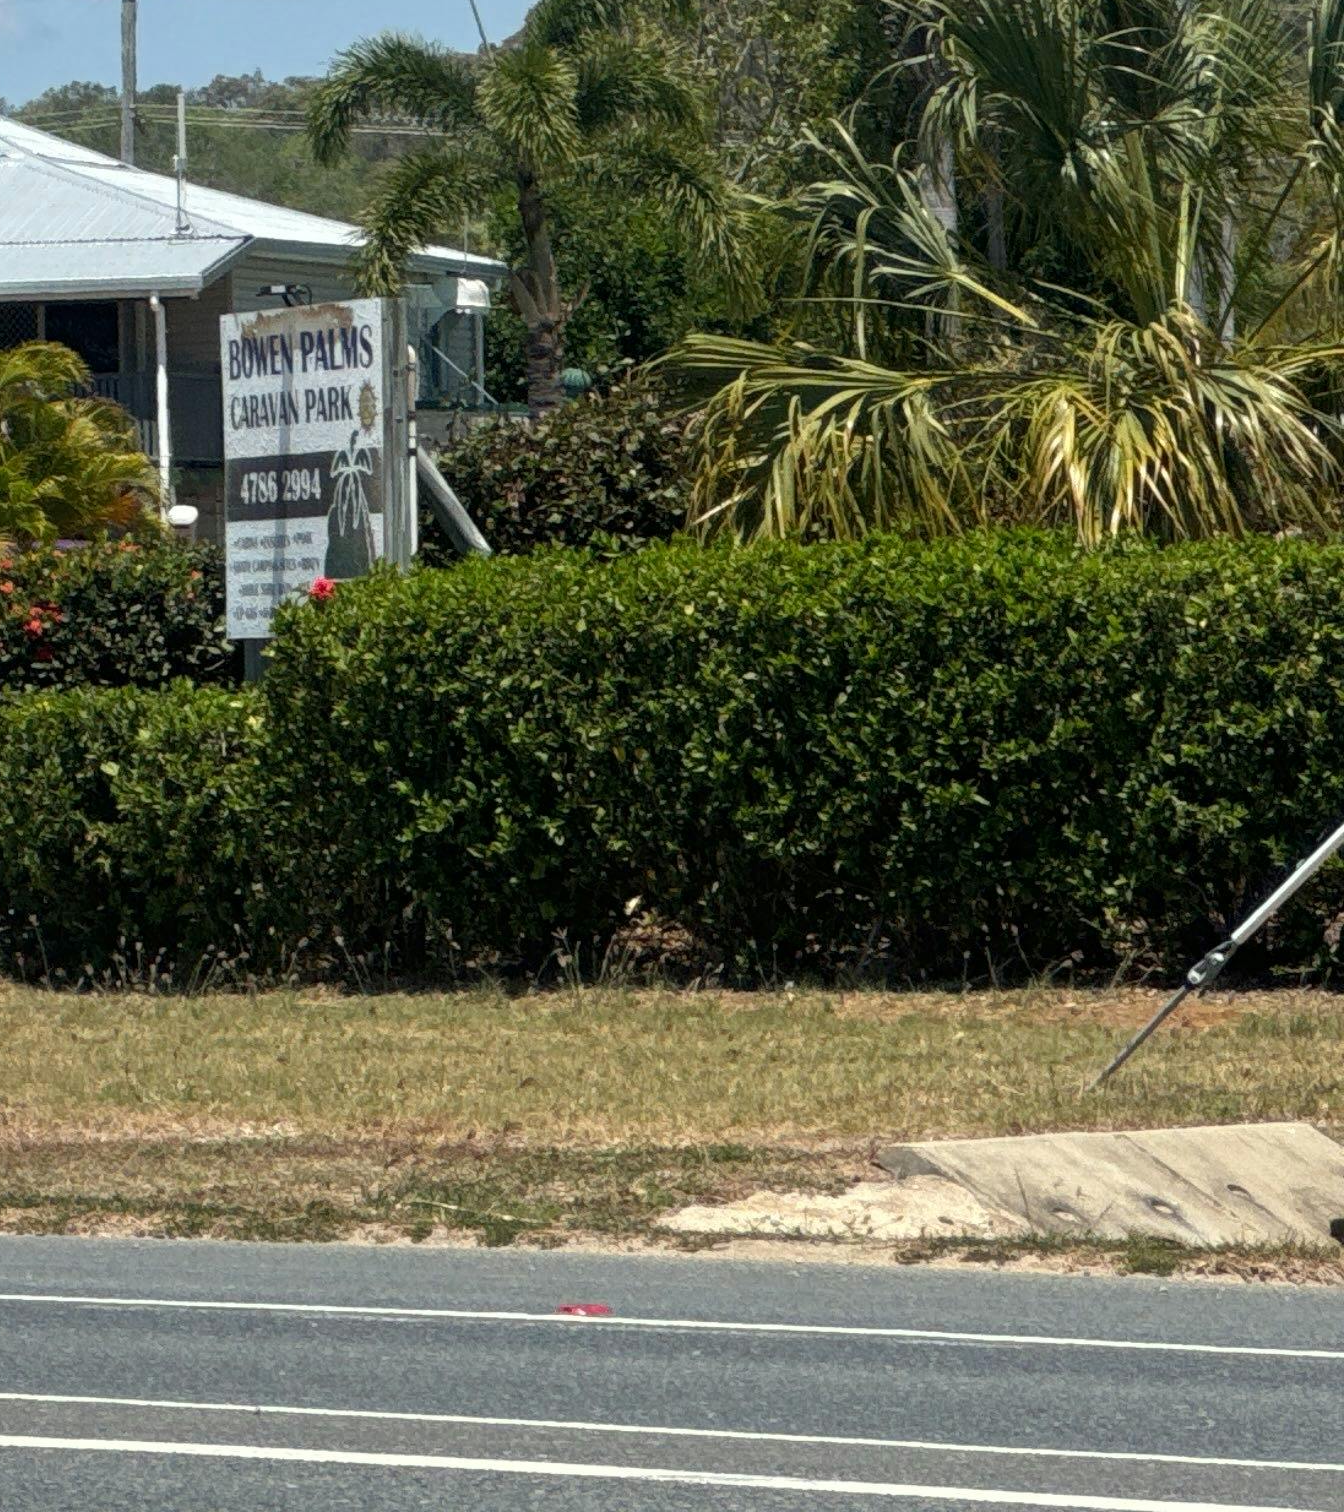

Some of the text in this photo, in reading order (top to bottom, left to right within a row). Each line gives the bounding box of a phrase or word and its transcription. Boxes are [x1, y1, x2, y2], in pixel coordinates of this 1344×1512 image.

[229, 325, 373, 380] BOWEN PALMS
[231, 385, 353, 431] CARAVAN PARK
[241, 467, 321, 505] 4786 2994
